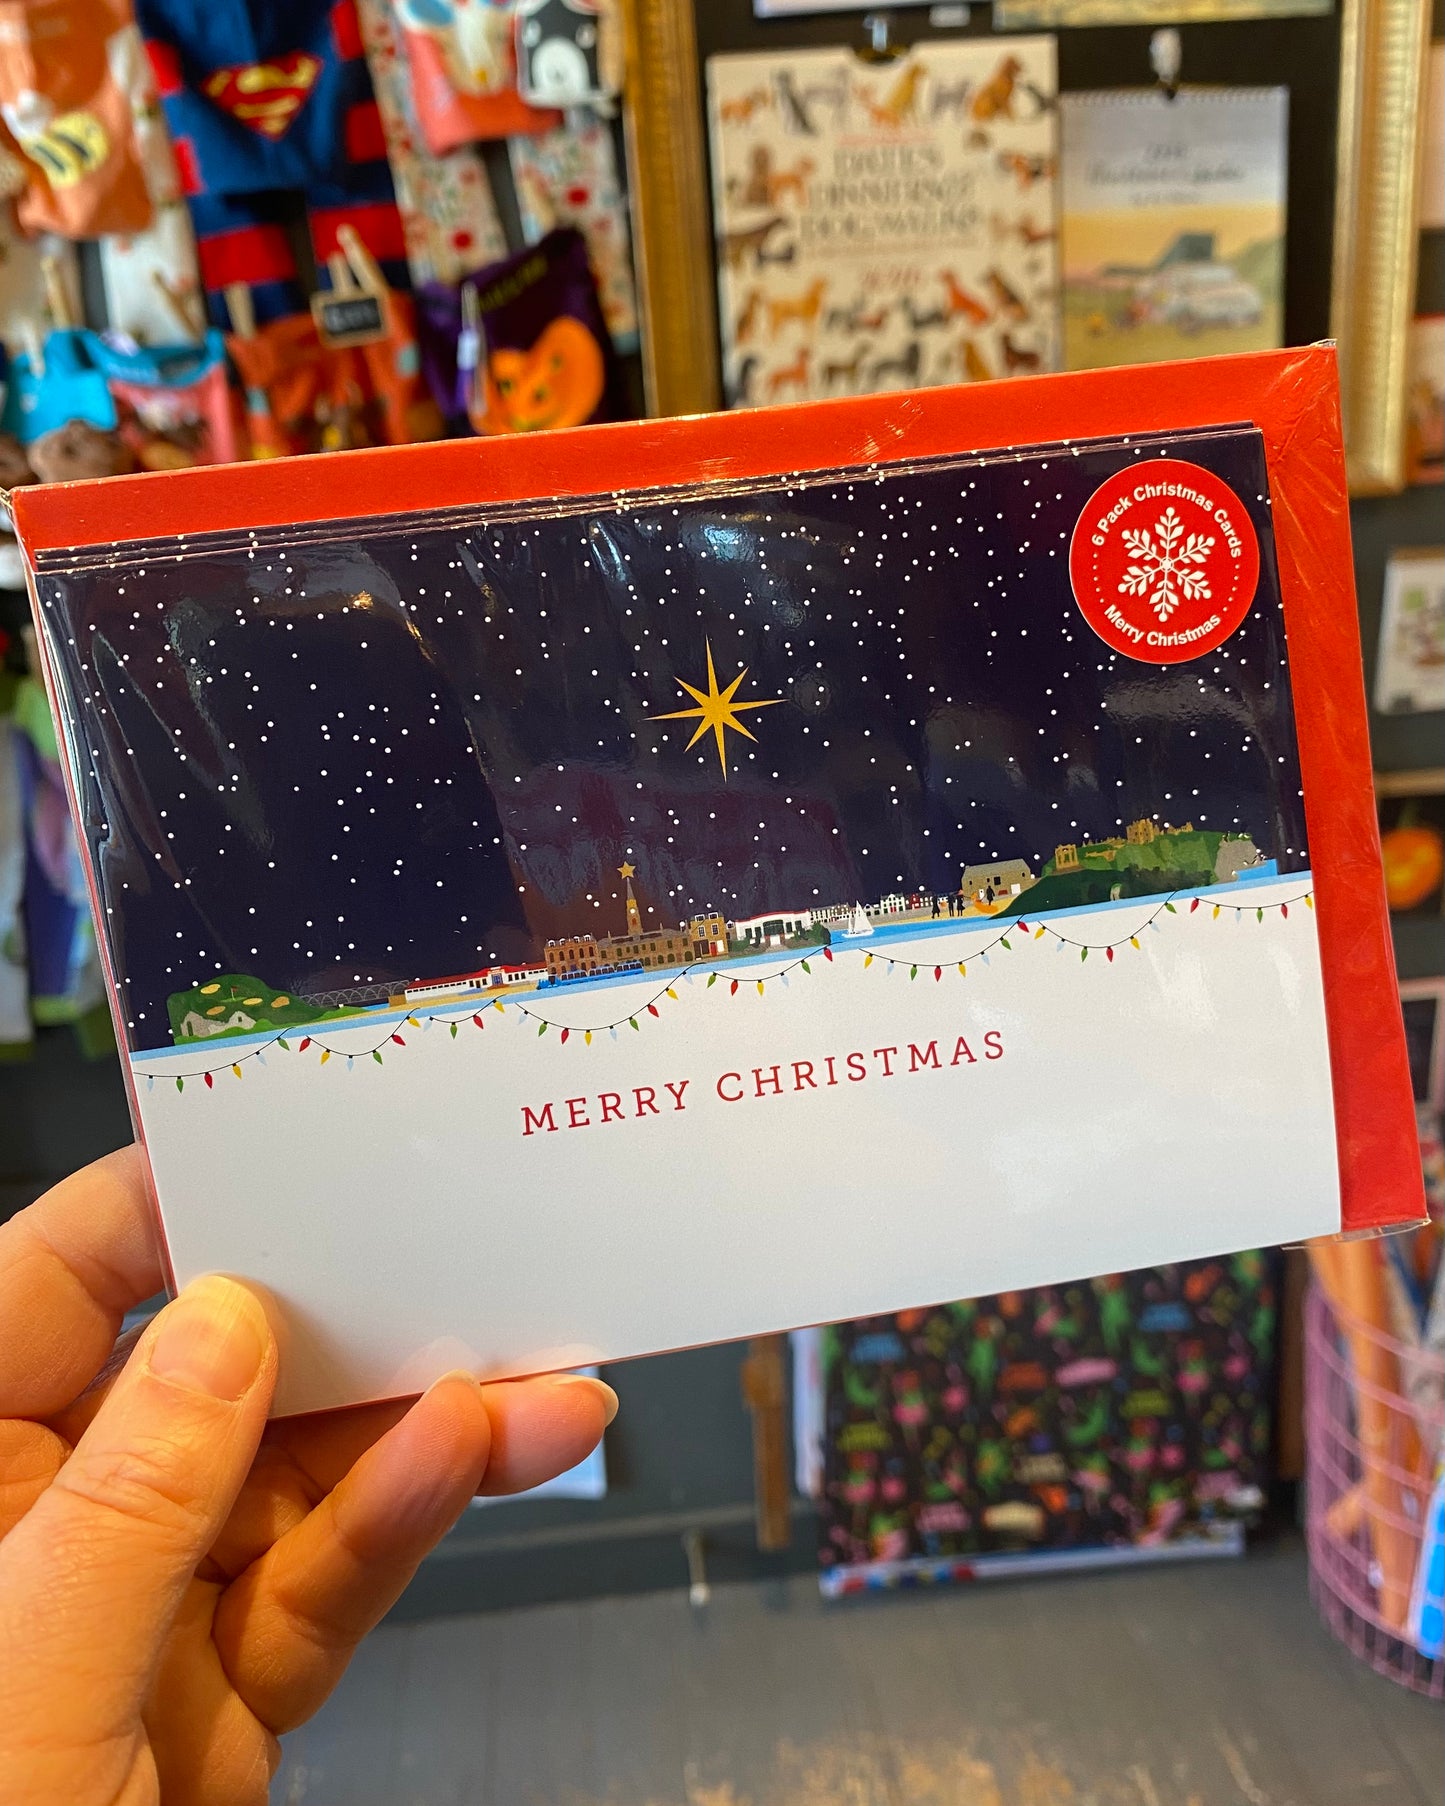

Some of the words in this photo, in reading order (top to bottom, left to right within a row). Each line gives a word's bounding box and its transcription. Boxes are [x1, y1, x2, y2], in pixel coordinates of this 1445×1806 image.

[1097, 496, 1133, 534] Pack
[1133, 482, 1215, 512] Christmas
[1091, 533, 1105, 546] 6
[1213, 509, 1242, 558] Cards
[1104, 604, 1145, 644] Merry
[1146, 614, 1221, 646] Christmas
[521, 1080, 690, 1136] MERRY
[716, 1030, 1004, 1102] CHRISTMAS
